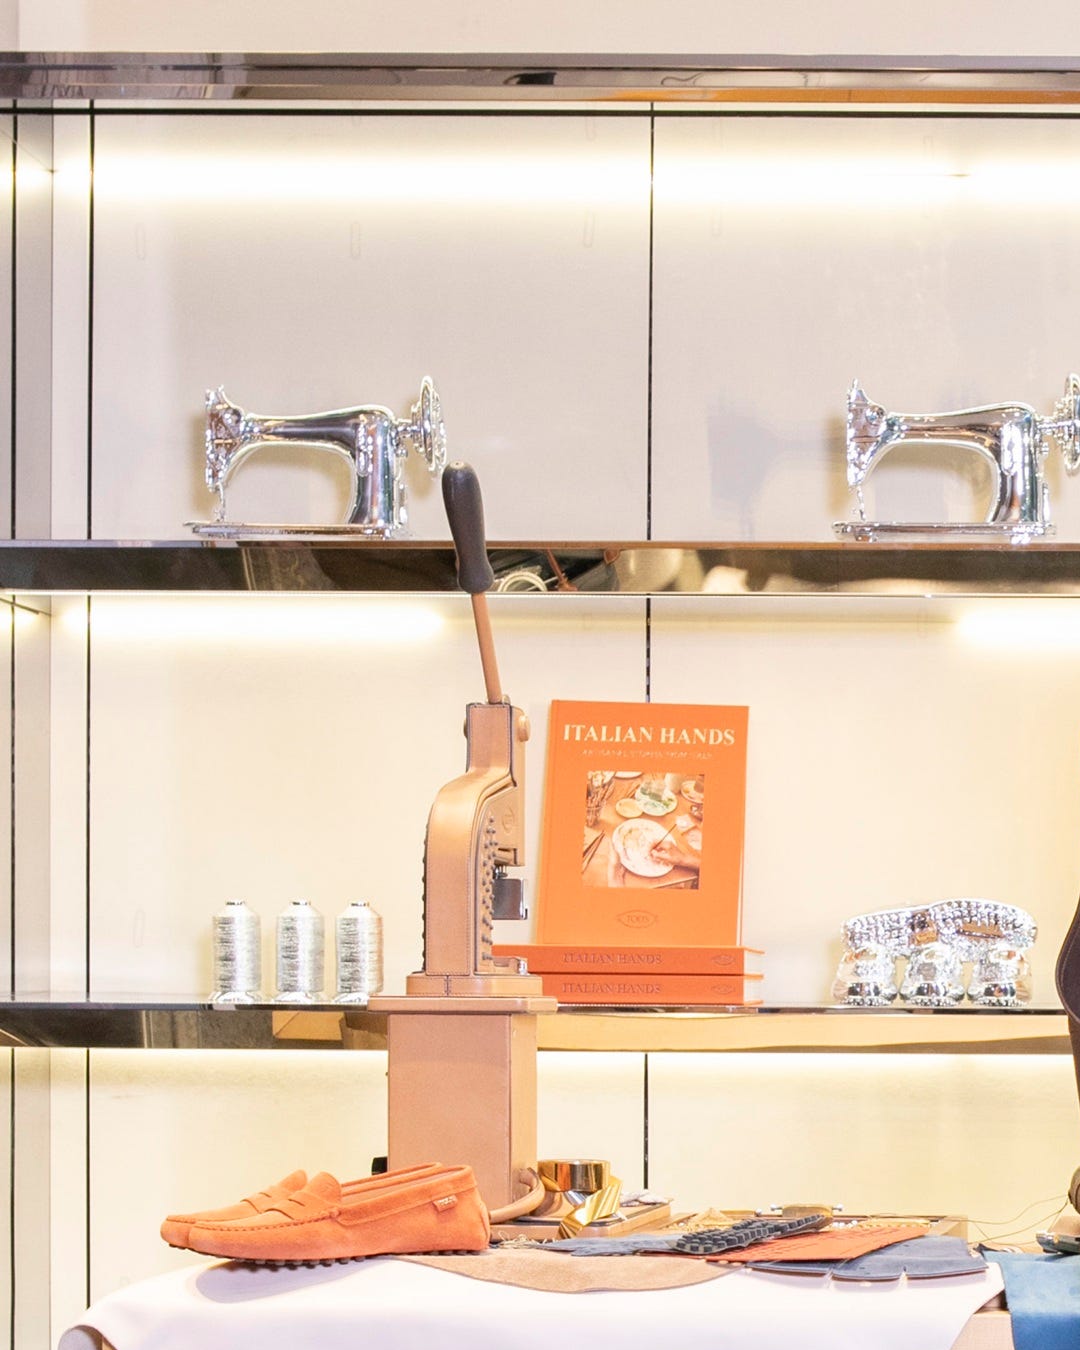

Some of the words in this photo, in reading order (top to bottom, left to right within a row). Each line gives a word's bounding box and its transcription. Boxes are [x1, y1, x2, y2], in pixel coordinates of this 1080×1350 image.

[563, 724, 653, 743] ITALIAN
[660, 727, 735, 746] HANDS
[562, 953, 615, 965] ITALIAN
[617, 953, 663, 965] HANDS
[562, 982, 614, 994] ITALIAN
[616, 983, 662, 995] HANDS
